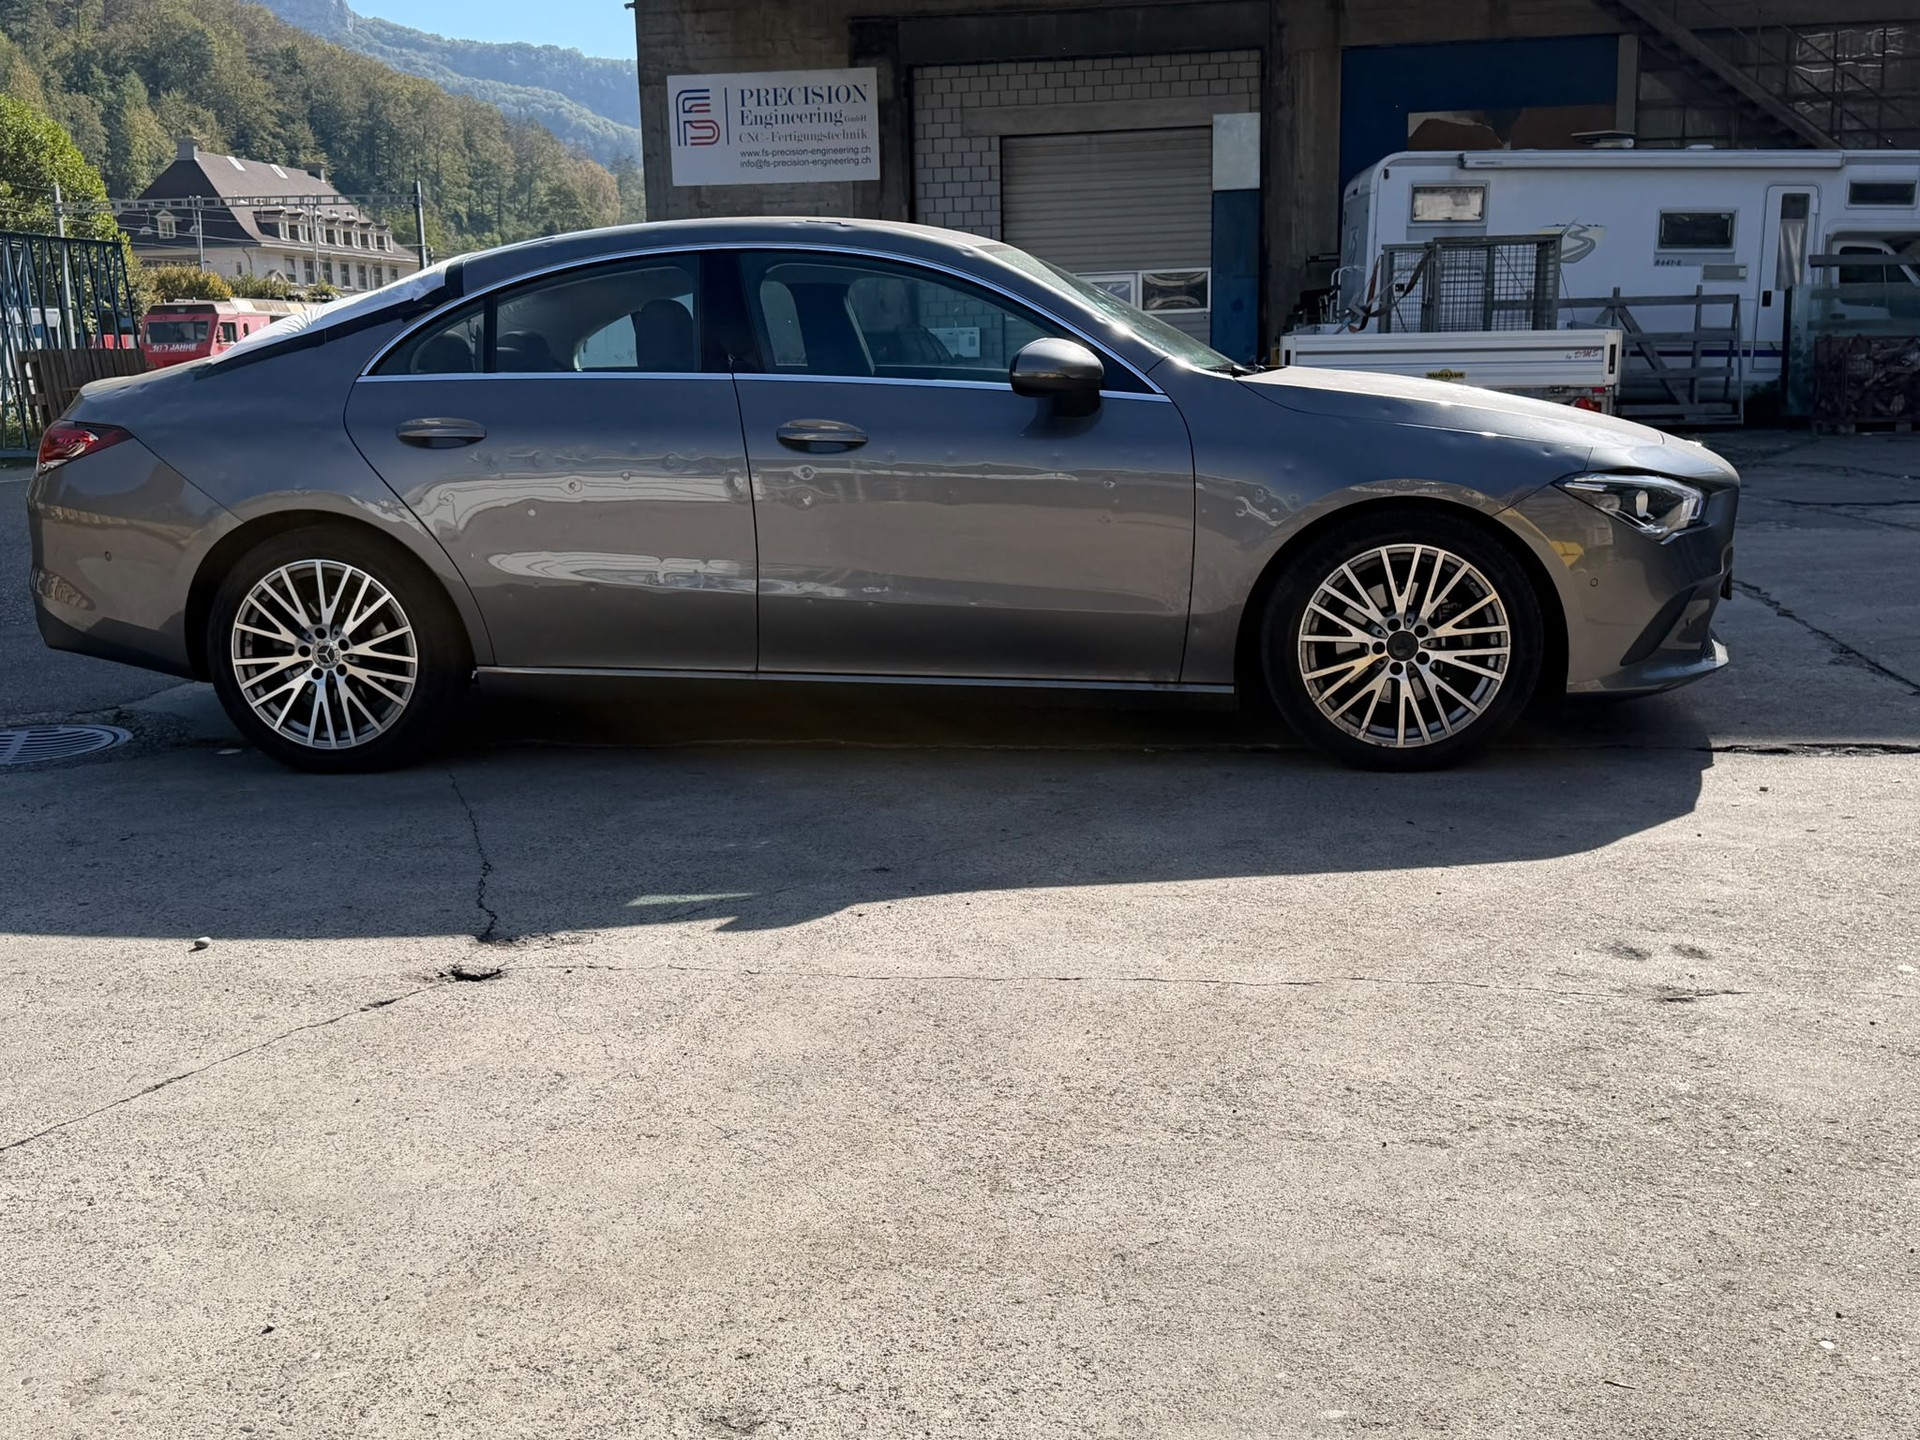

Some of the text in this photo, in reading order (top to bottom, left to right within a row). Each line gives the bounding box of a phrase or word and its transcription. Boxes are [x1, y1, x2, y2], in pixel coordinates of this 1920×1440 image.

[739, 83, 868, 108] PRECISION
[740, 107, 844, 129] Engineering
[740, 145, 872, 158] www.fs-precision-engineering.ch
[740, 155, 872, 169] info@fs-precision-engineering.ch
